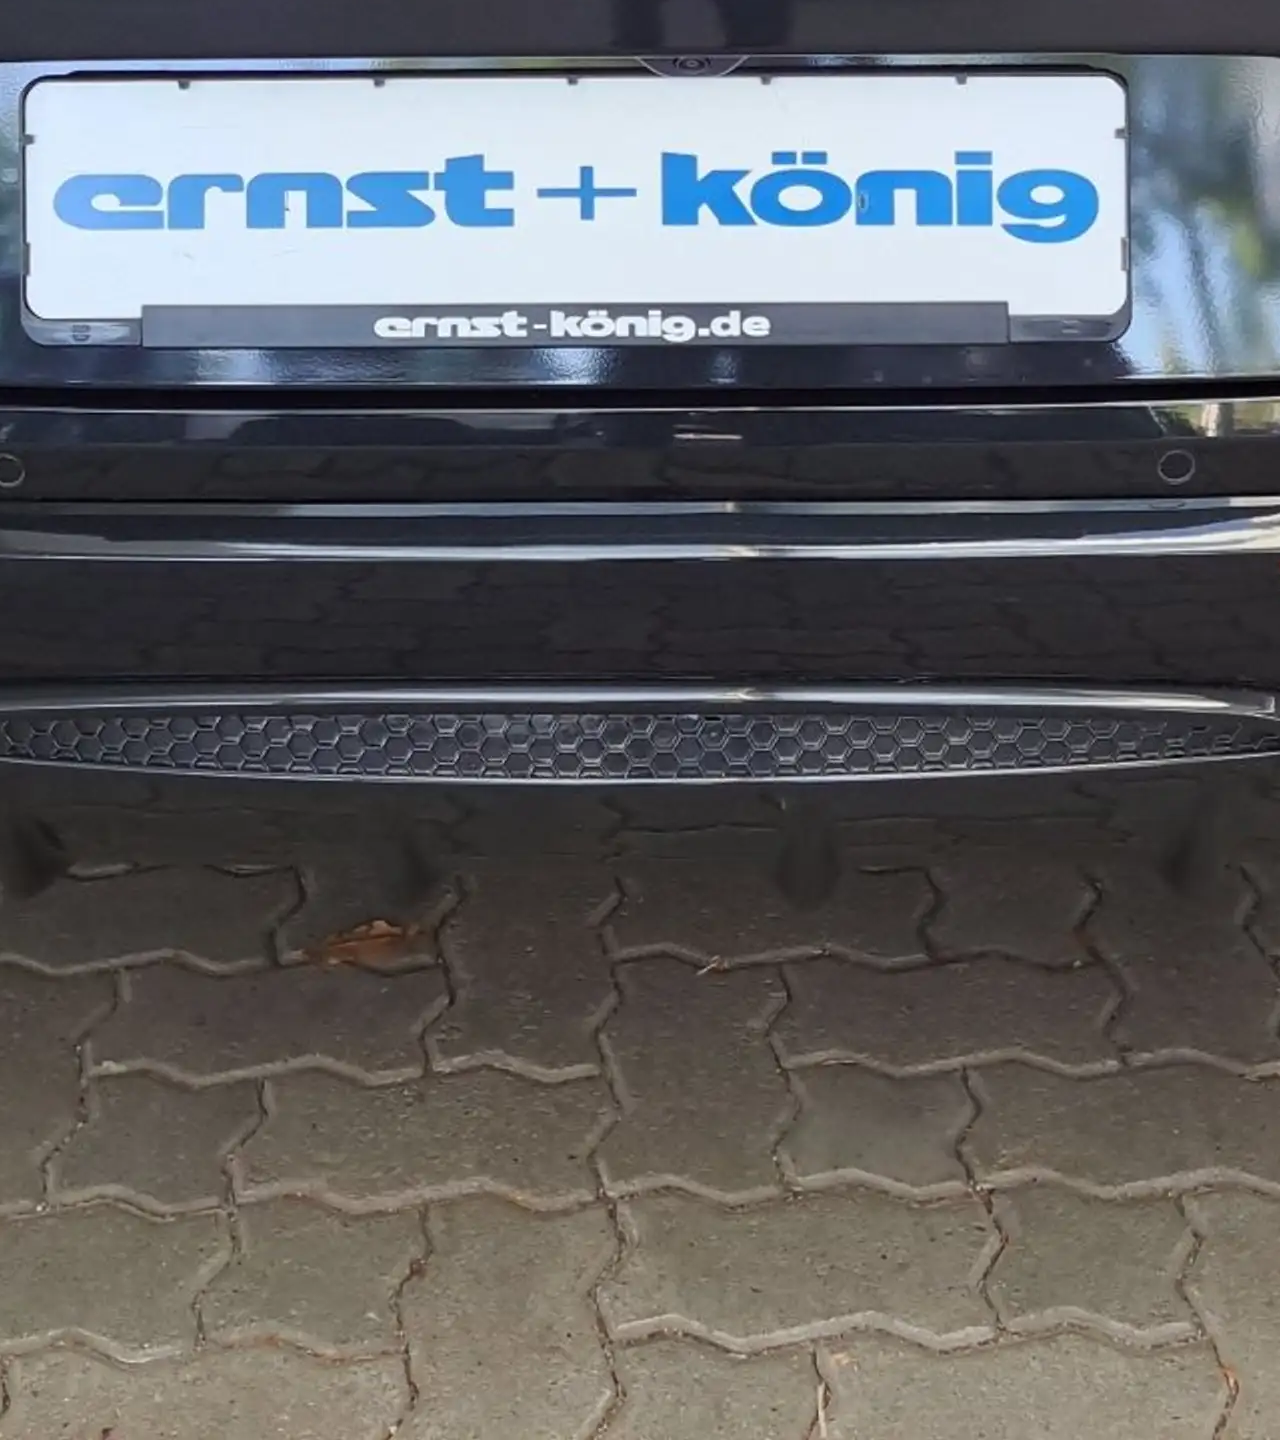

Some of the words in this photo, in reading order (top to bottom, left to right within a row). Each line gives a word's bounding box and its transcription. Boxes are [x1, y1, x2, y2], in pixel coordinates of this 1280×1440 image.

[53, 154, 515, 231] ernst
[661, 150, 1099, 244] könig
[374, 309, 771, 342] ernst-könig.de
